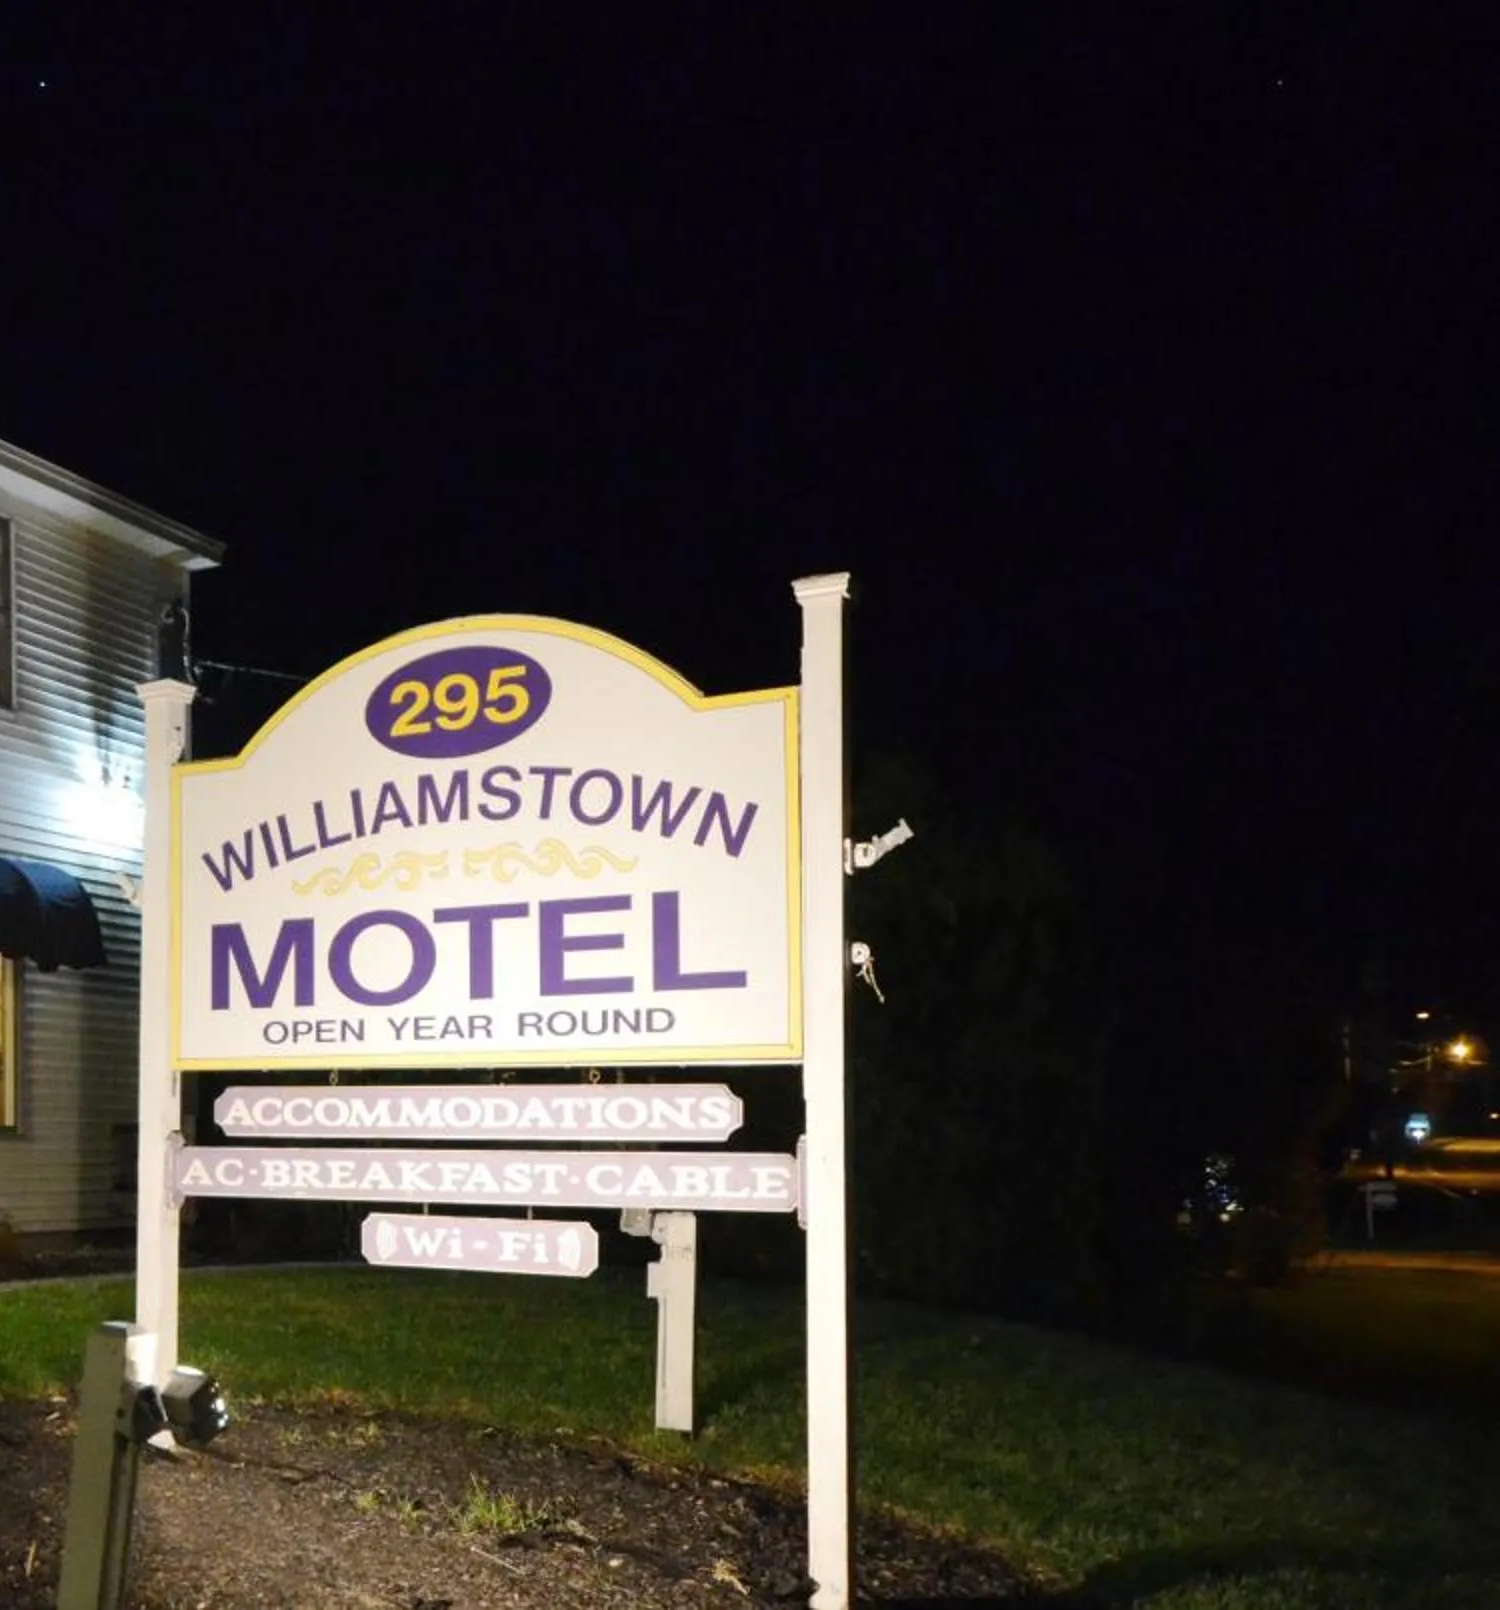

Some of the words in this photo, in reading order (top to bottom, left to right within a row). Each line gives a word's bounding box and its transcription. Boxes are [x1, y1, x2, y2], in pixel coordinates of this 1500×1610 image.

[389, 664, 531, 738] 295
[201, 765, 759, 893] WILLIAMSTOWN
[210, 890, 748, 1011] MOTEL
[262, 1018, 366, 1045] OPEN
[386, 1014, 494, 1041] YEAR
[517, 1007, 677, 1038] ROUND
[222, 1095, 733, 1131] ACCOMMODATIONS
